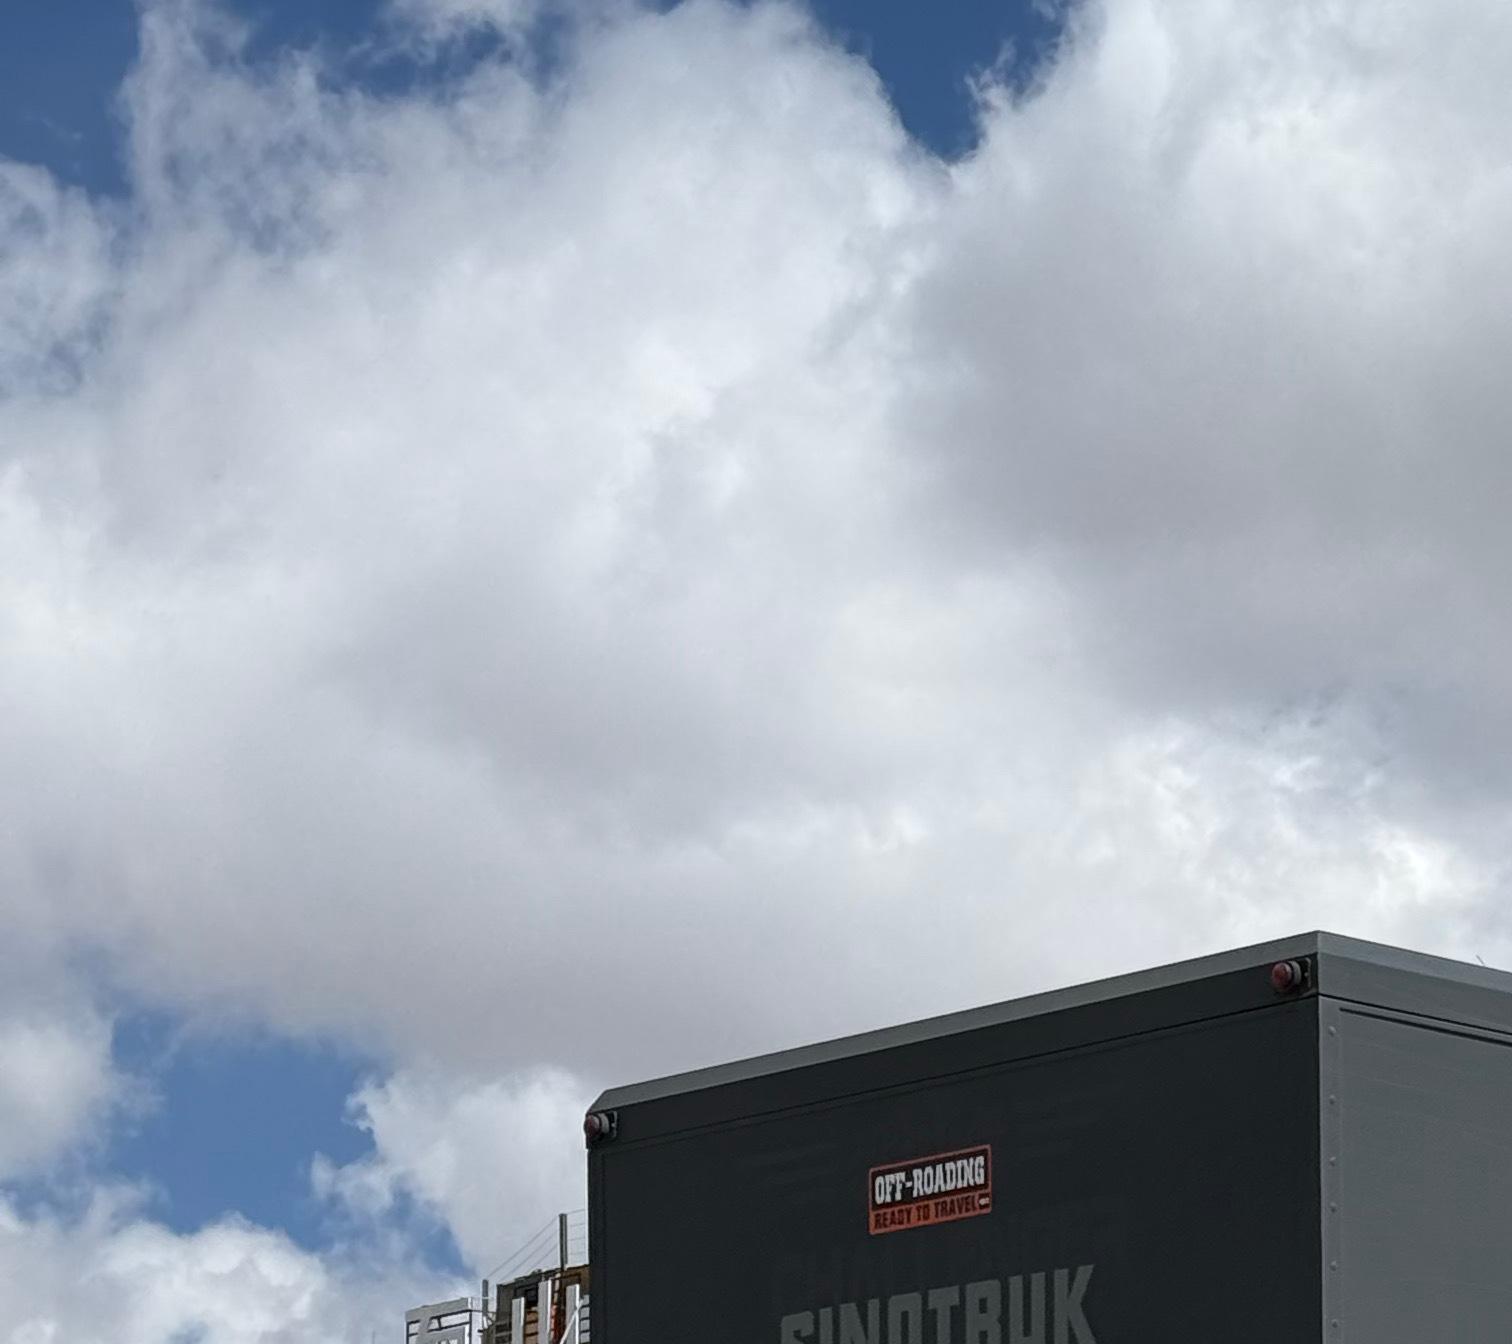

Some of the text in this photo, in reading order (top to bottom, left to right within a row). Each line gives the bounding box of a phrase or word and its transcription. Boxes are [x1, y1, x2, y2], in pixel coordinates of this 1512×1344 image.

[874, 1155, 985, 1205] OFF-ROADING
[874, 1206, 914, 1230] READY
[916, 1202, 931, 1222] TO
[934, 1196, 976, 1219] TRAVEL
